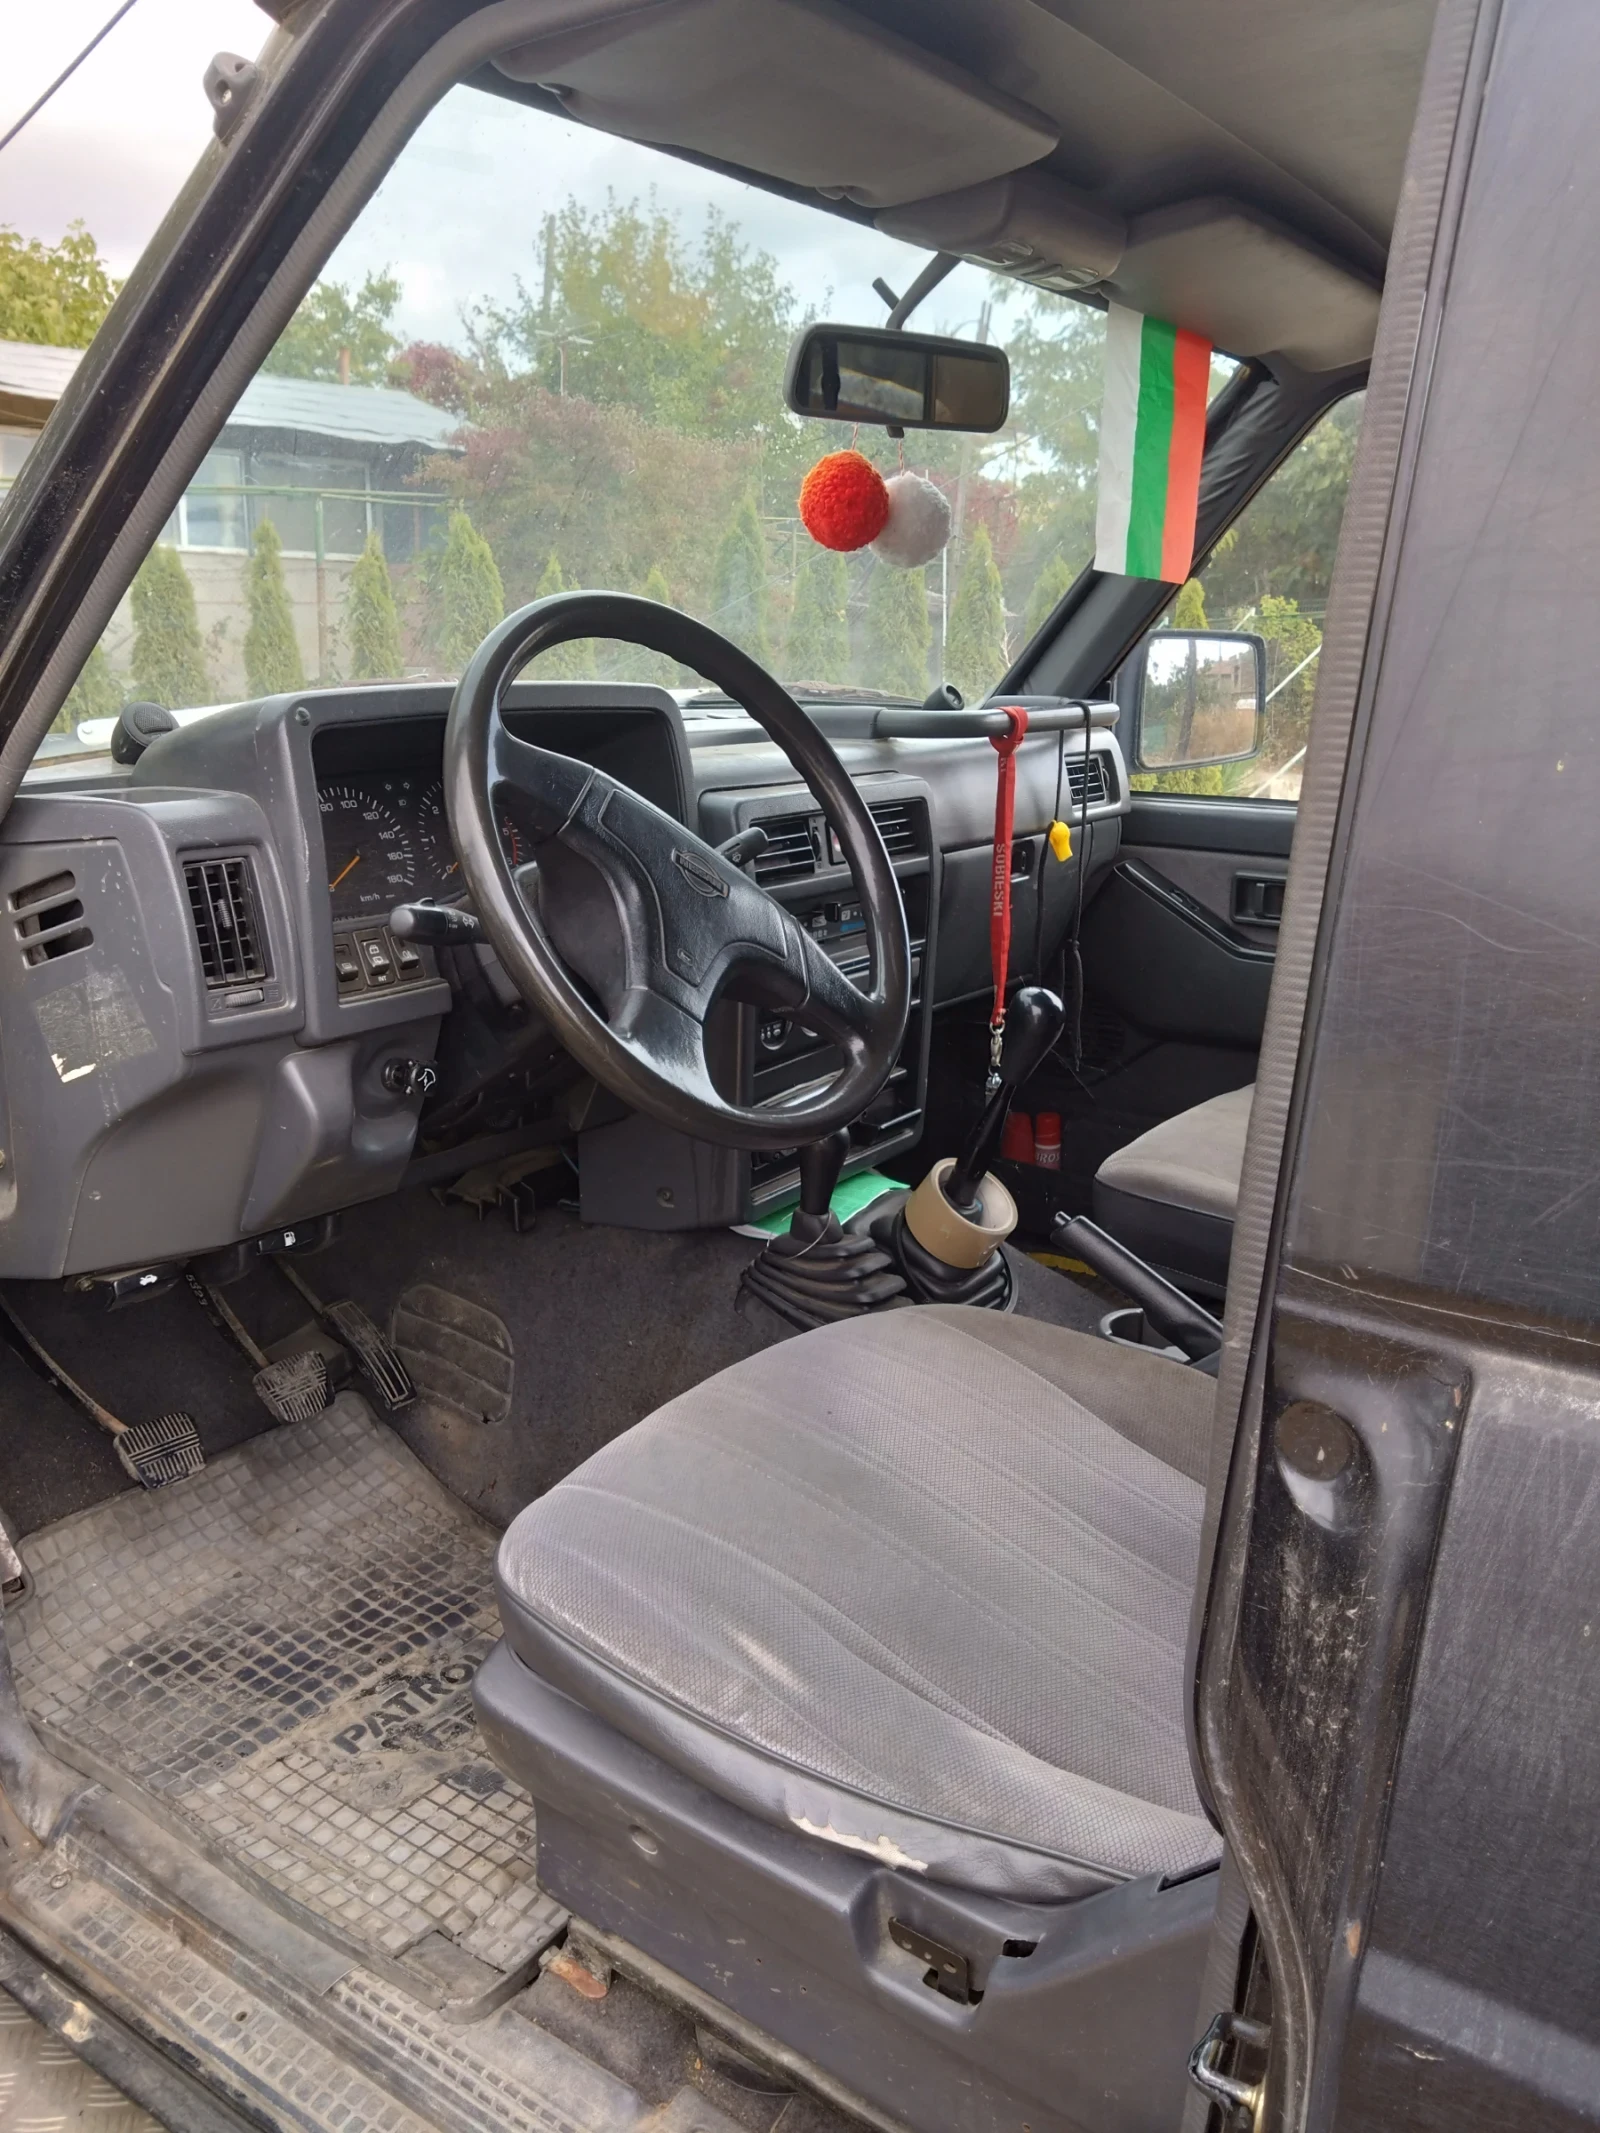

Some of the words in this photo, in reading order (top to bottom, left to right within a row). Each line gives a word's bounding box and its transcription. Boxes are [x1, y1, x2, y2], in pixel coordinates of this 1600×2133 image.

[340, 800, 358, 809] 100
[431, 806, 440, 815] 2
[362, 811, 380, 821] 120
[378, 831, 395, 840] 140
[502, 827, 510, 836] 5
[430, 836, 436, 844] 1
[387, 851, 404, 861] 160
[387, 874, 404, 884] 180
[992, 843, 1006, 917] SUBIESKI
[360, 893, 381, 903] km/h
